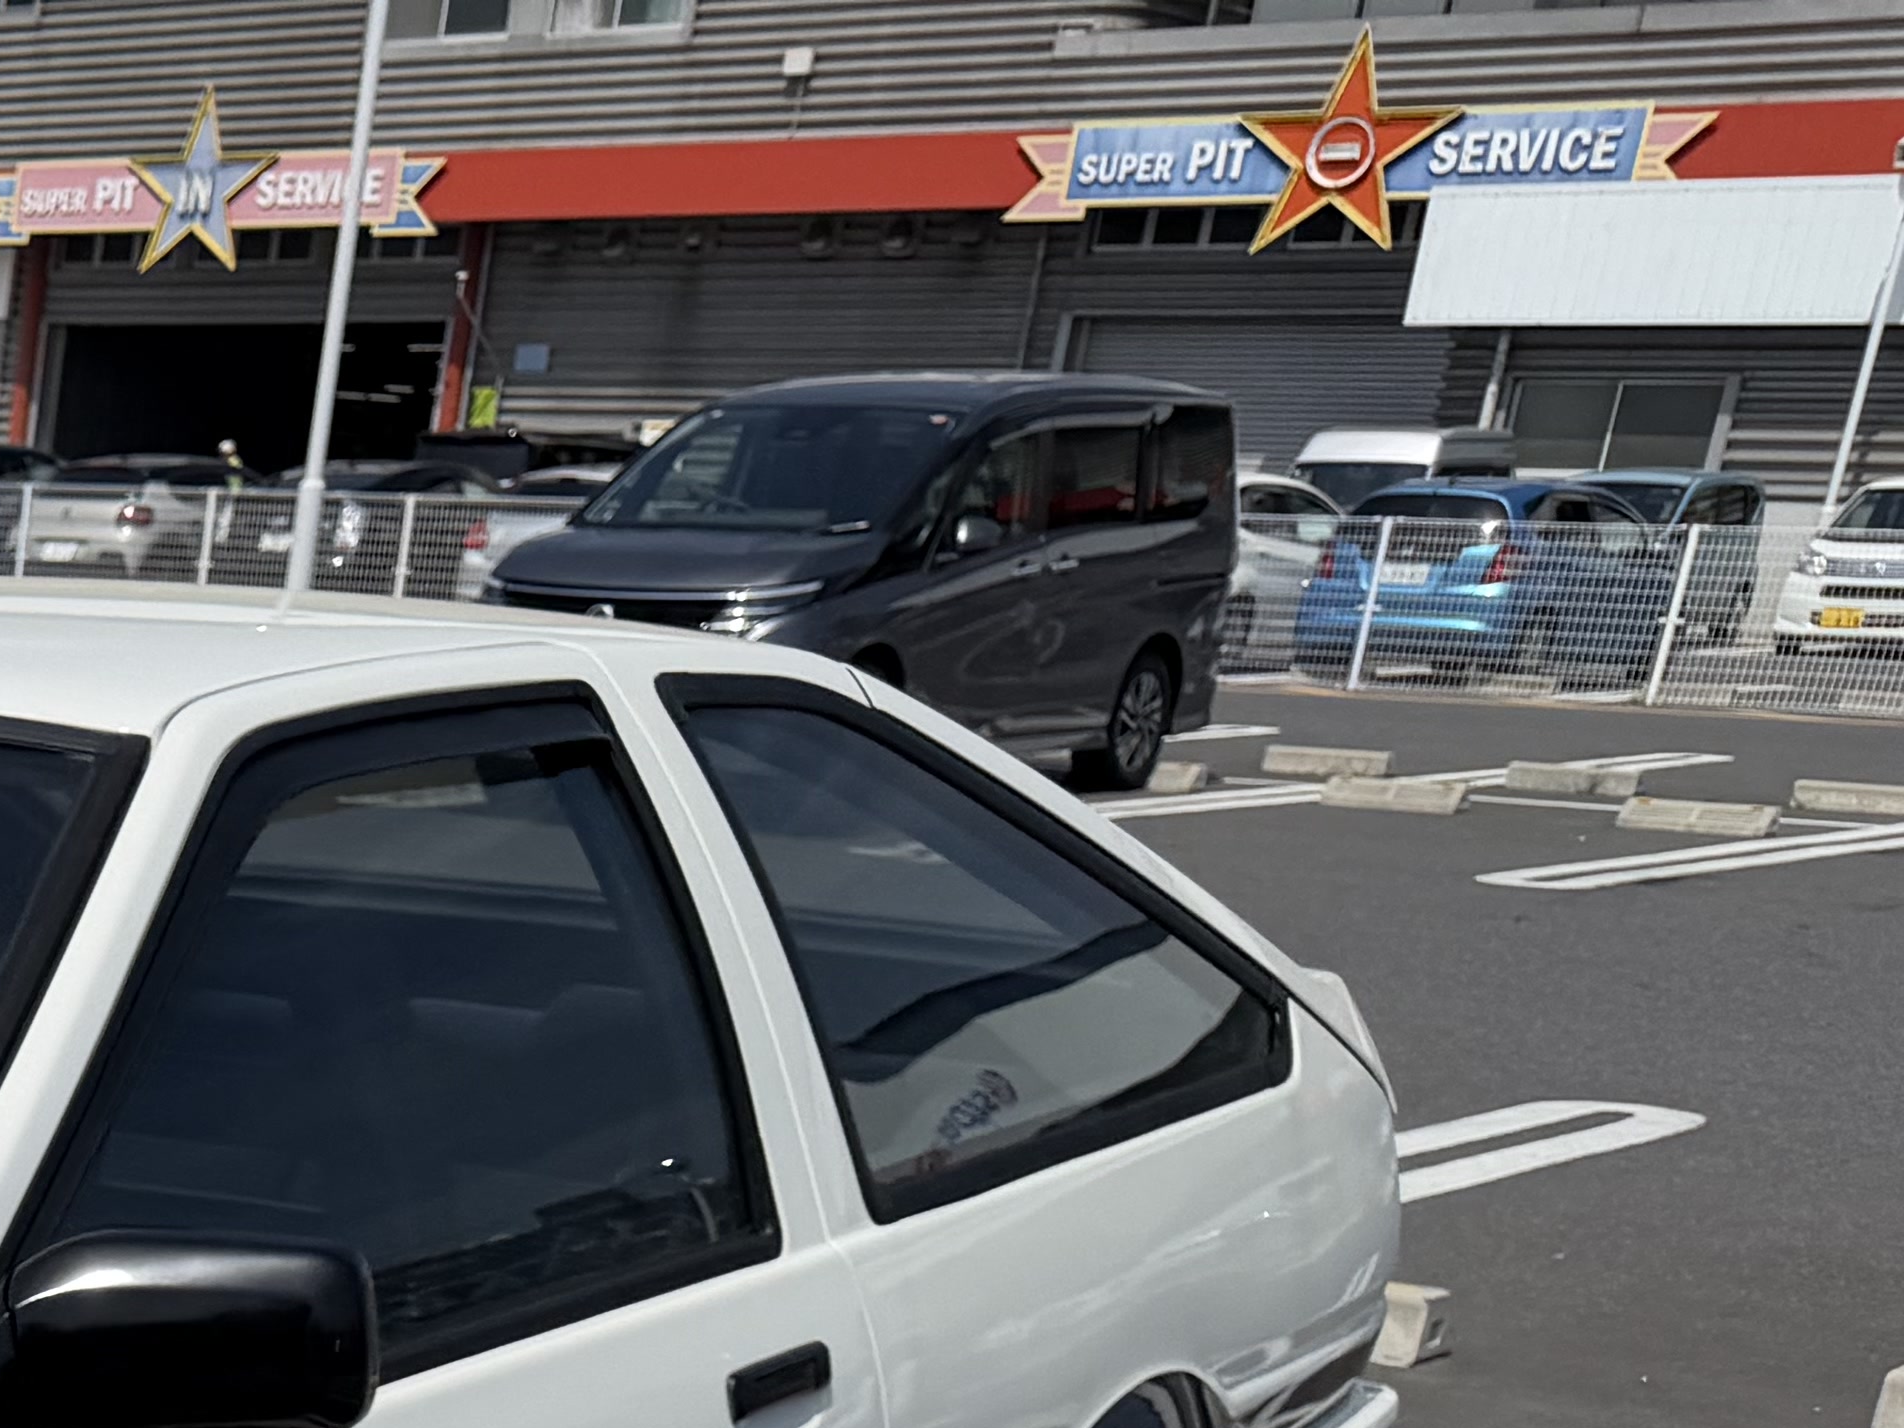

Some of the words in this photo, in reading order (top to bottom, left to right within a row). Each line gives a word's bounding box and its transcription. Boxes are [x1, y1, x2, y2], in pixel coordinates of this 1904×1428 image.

[1076, 151, 1174, 186] SUPER
[1186, 138, 1255, 183] PIT
[1428, 124, 1626, 177] SERVICE
[20, 186, 87, 216] SUPER
[93, 176, 140, 214] PIT
[176, 173, 214, 217] IN
